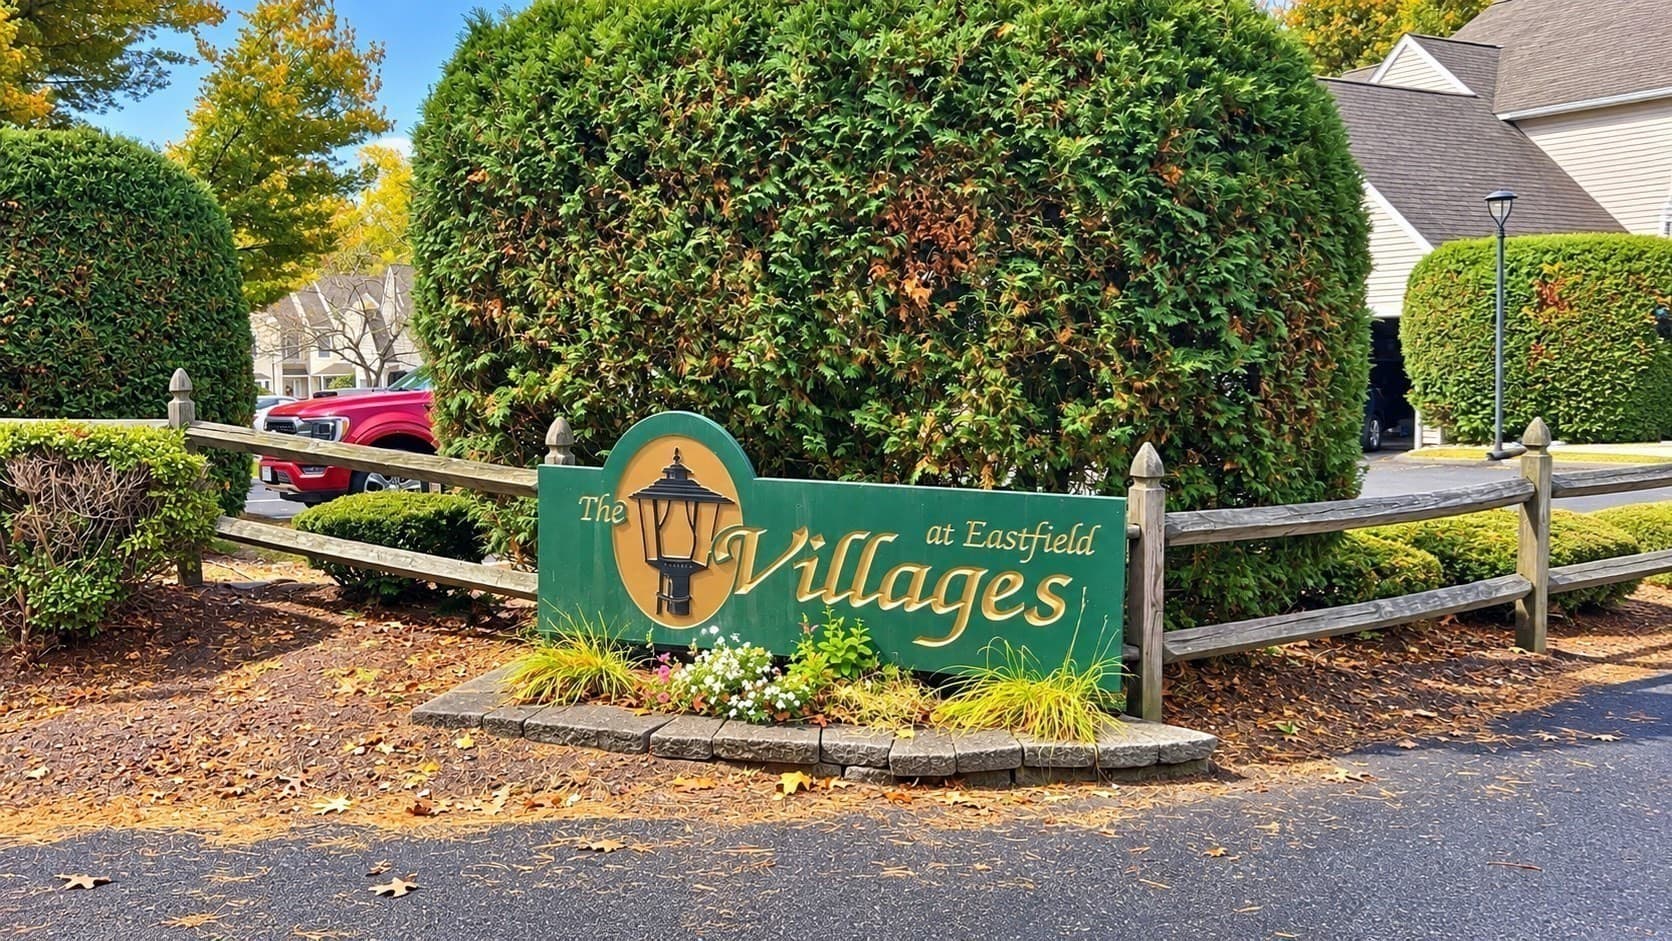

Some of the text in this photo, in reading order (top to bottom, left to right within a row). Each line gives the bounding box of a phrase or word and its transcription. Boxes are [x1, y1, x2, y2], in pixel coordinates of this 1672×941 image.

[578, 493, 627, 524] The
[925, 520, 1102, 564] at Eastfield
[712, 524, 1073, 648] Villages
